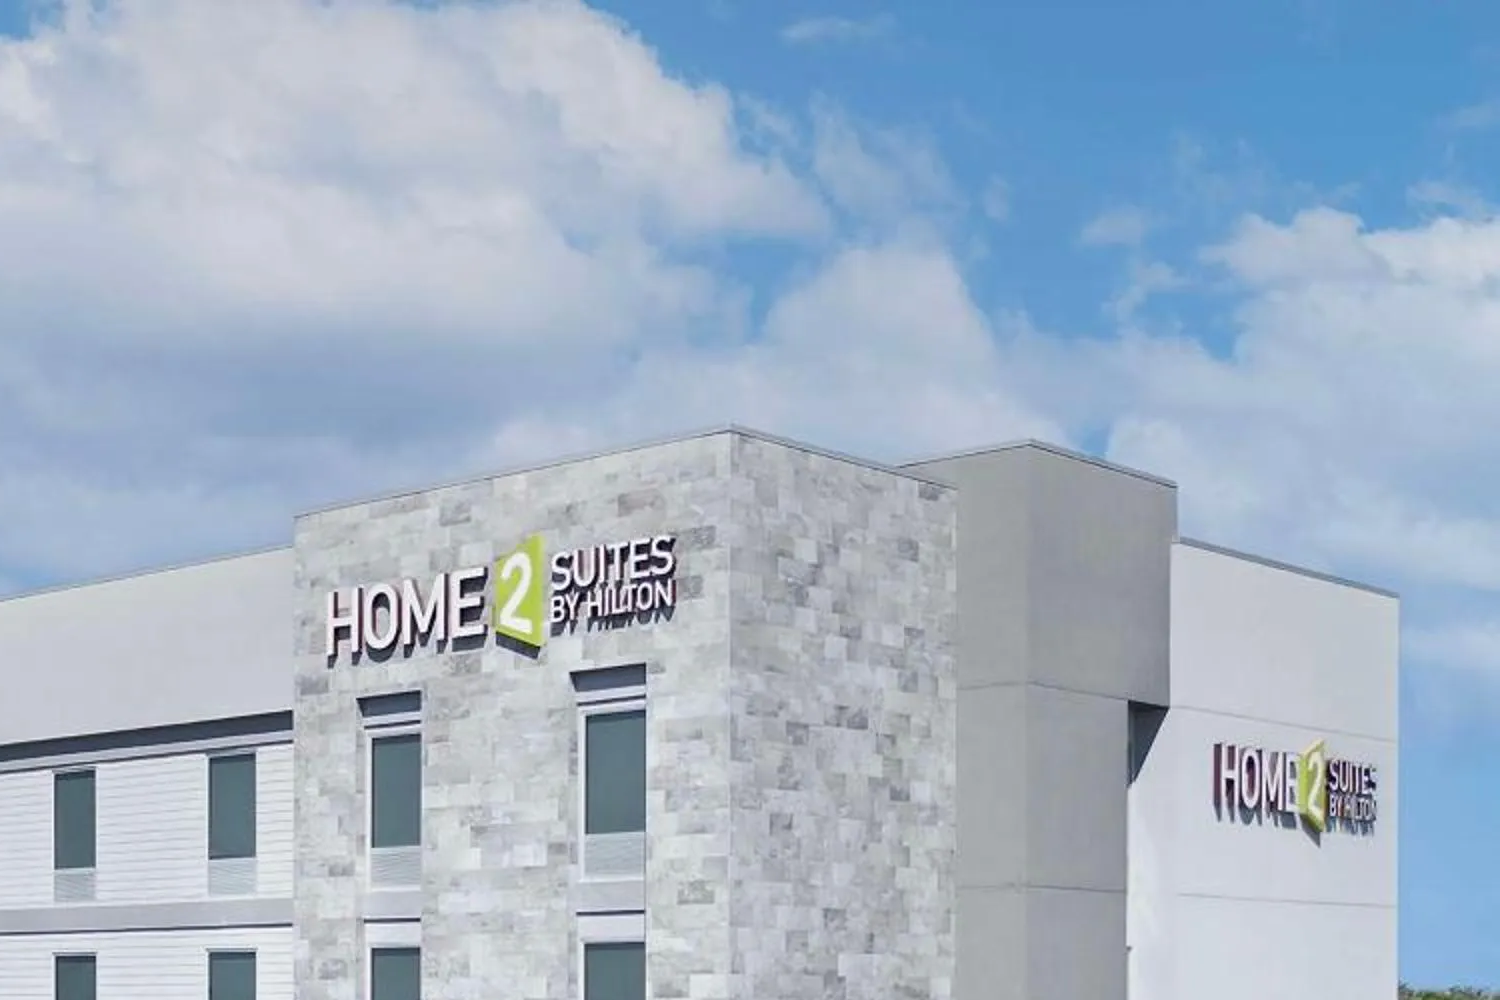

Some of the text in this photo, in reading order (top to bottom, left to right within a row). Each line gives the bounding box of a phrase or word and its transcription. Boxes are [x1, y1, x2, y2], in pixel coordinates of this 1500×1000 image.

[550, 535, 675, 591] SUITES
[326, 551, 534, 657] HOME 2
[550, 578, 674, 623] BY HILTON
[1216, 743, 1325, 830] HOME 2
